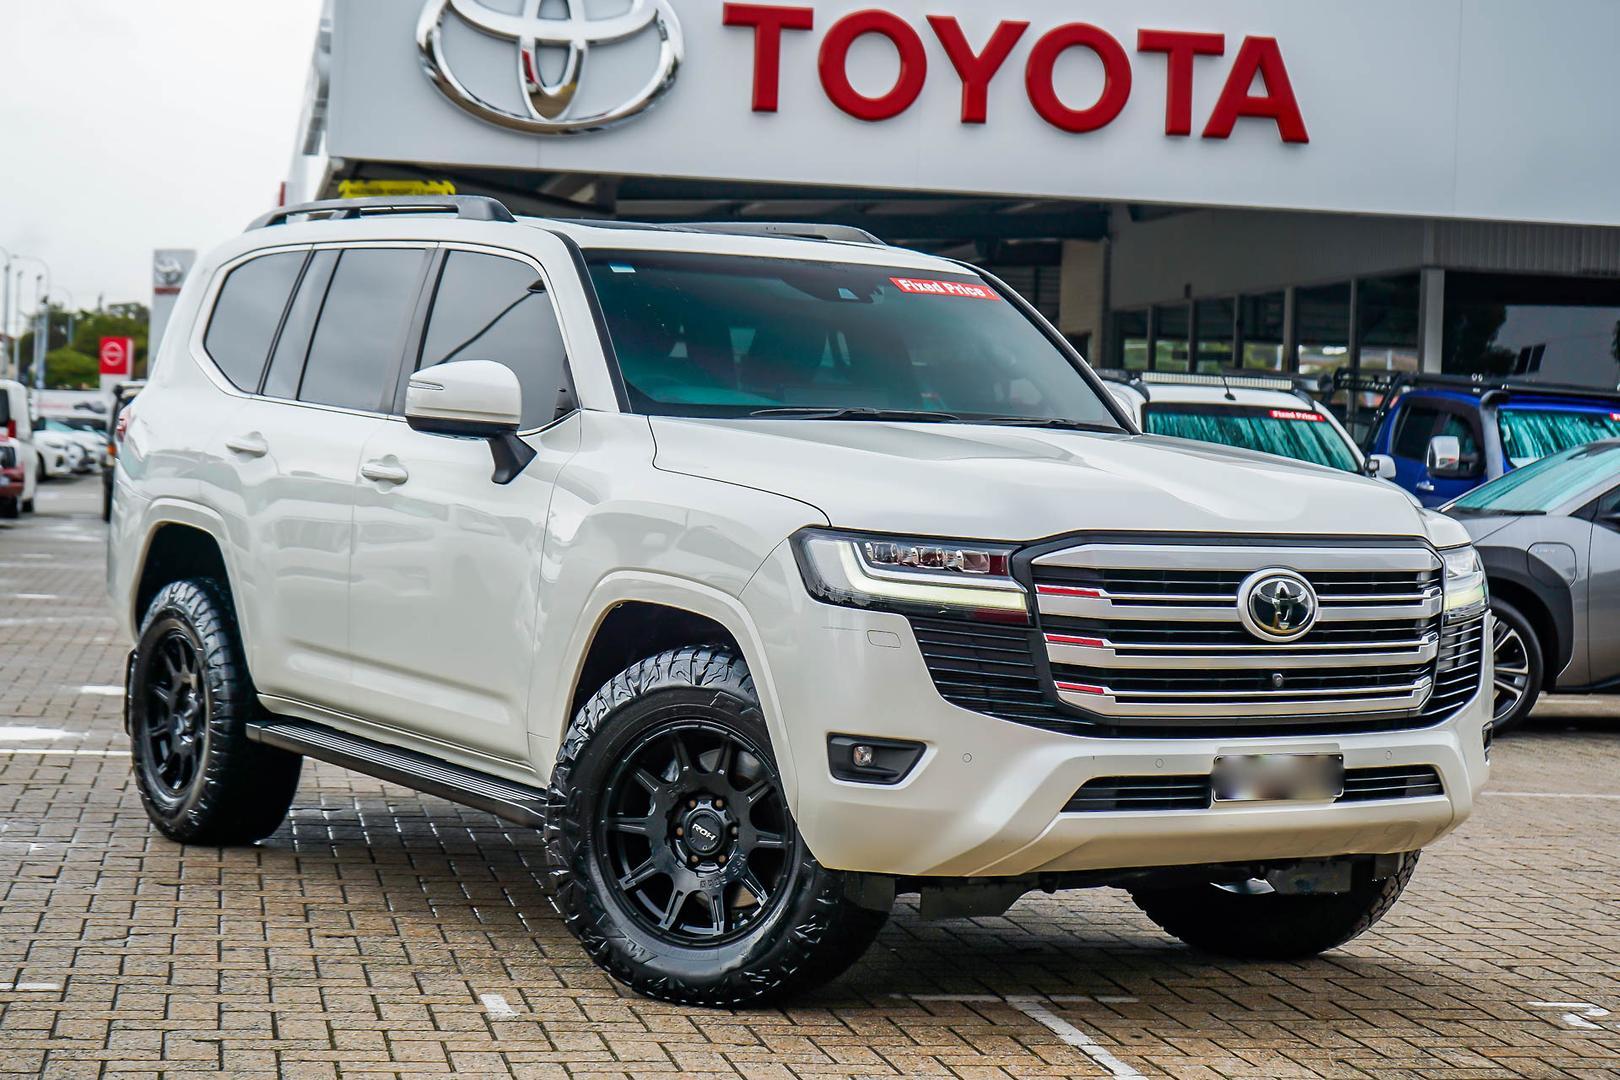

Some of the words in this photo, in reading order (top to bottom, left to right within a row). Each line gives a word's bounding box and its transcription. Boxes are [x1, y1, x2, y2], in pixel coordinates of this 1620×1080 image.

[723, 2, 1309, 144] TOYOTA
[898, 279, 945, 293] Fixed
[941, 282, 986, 297] Price
[692, 823, 717, 841] ROH
